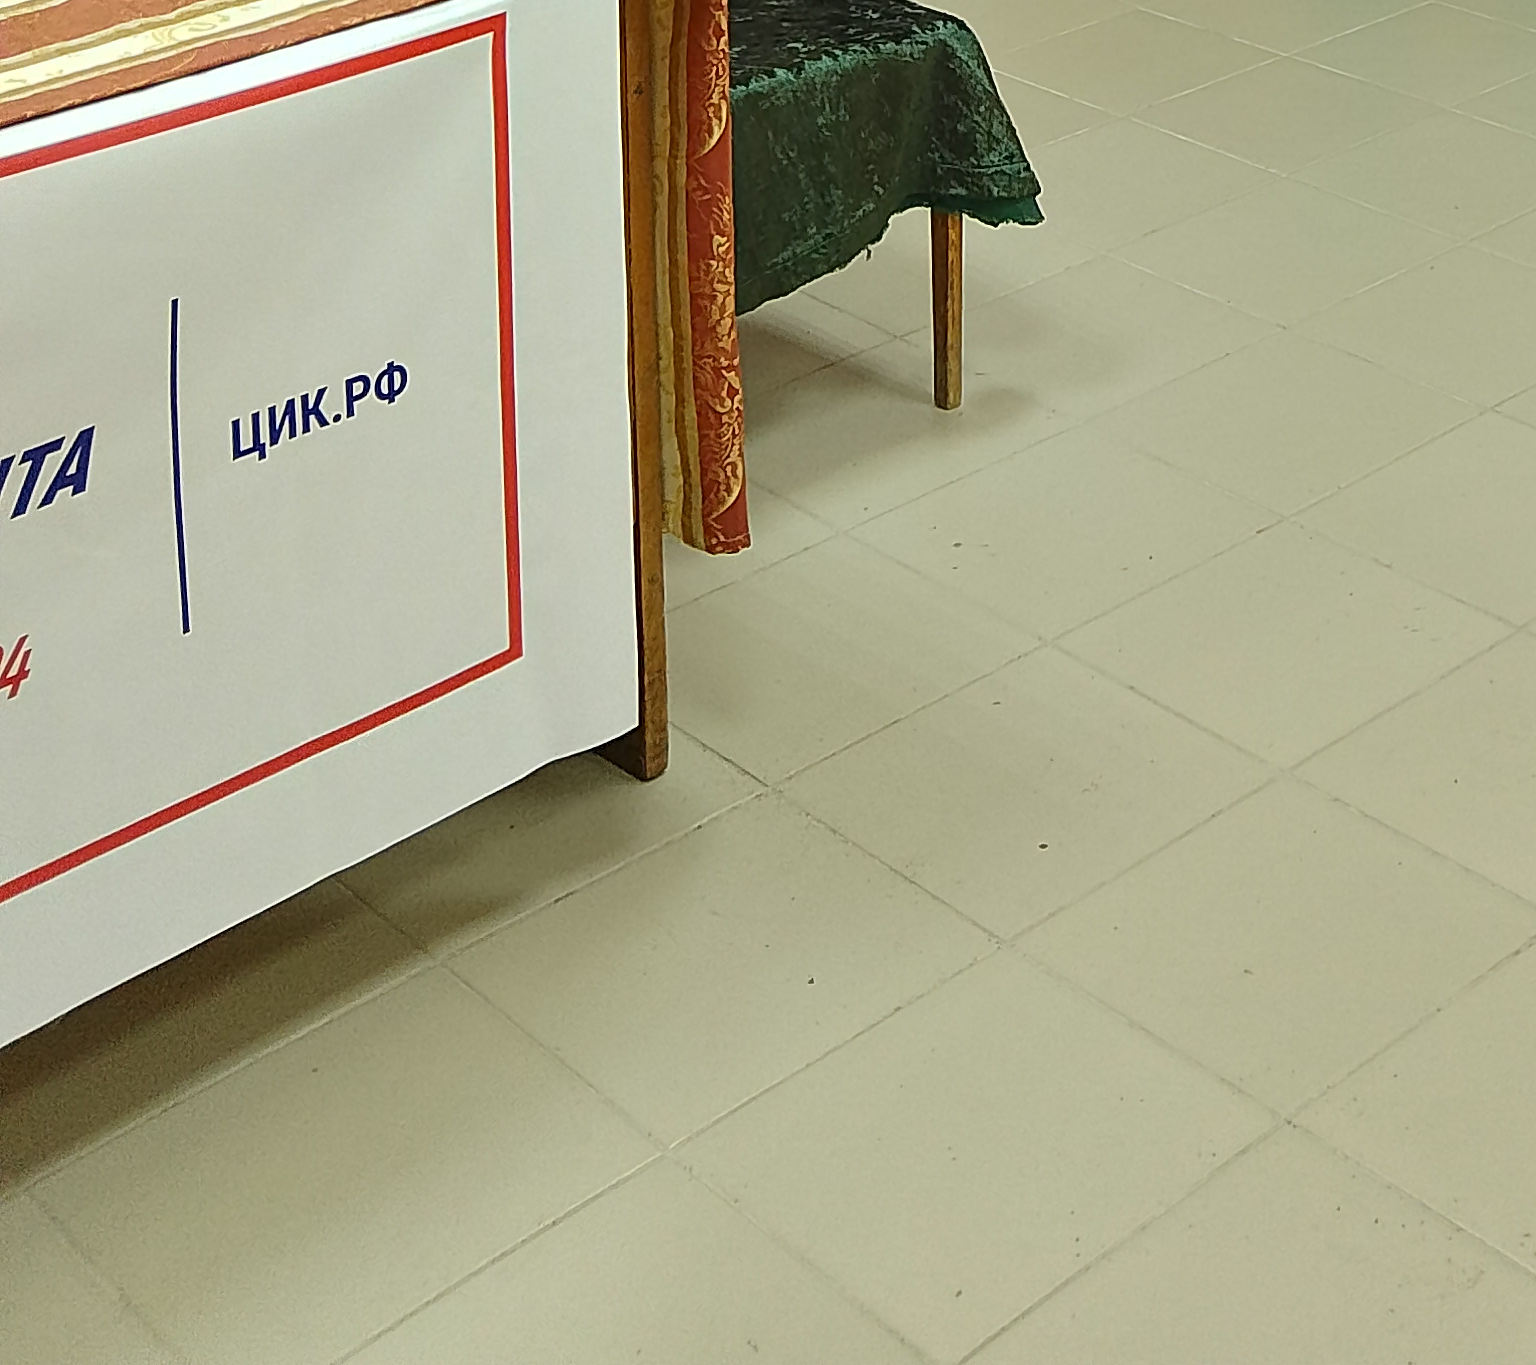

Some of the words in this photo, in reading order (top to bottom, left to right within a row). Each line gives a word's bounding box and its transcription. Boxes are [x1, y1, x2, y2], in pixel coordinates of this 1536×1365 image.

[0, 425, 96, 521] ТА
[230, 359, 410, 461] ЦИК.РФ
[0, 634, 32, 700] 4
